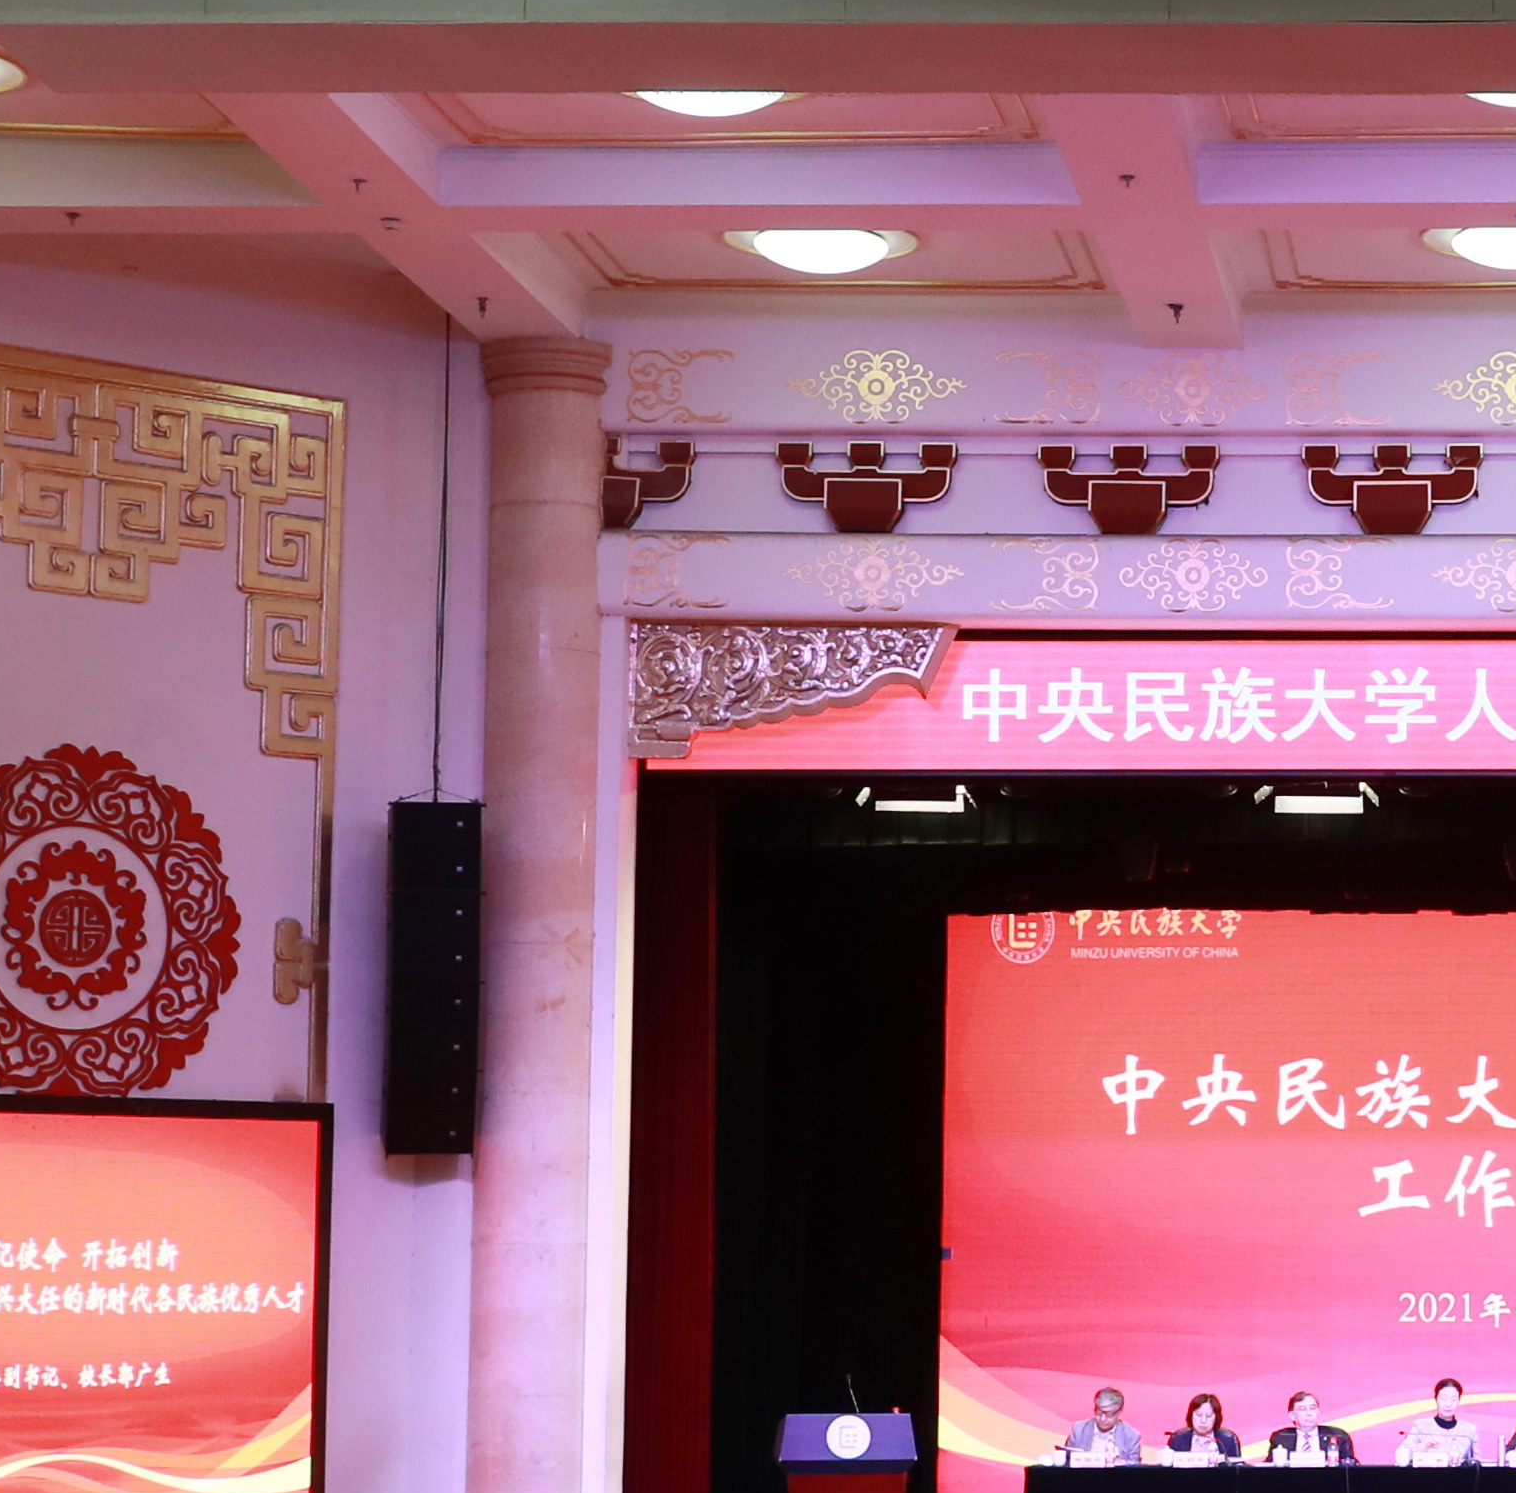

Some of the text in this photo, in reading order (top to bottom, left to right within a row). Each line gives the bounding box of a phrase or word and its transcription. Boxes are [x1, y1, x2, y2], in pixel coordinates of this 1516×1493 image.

[1069, 908, 1242, 941] 中央民族大学
[1071, 947, 1239, 959] MINZU UNIVERSITY OF CHINA
[81, 1237, 179, 1271] 开拓创新
